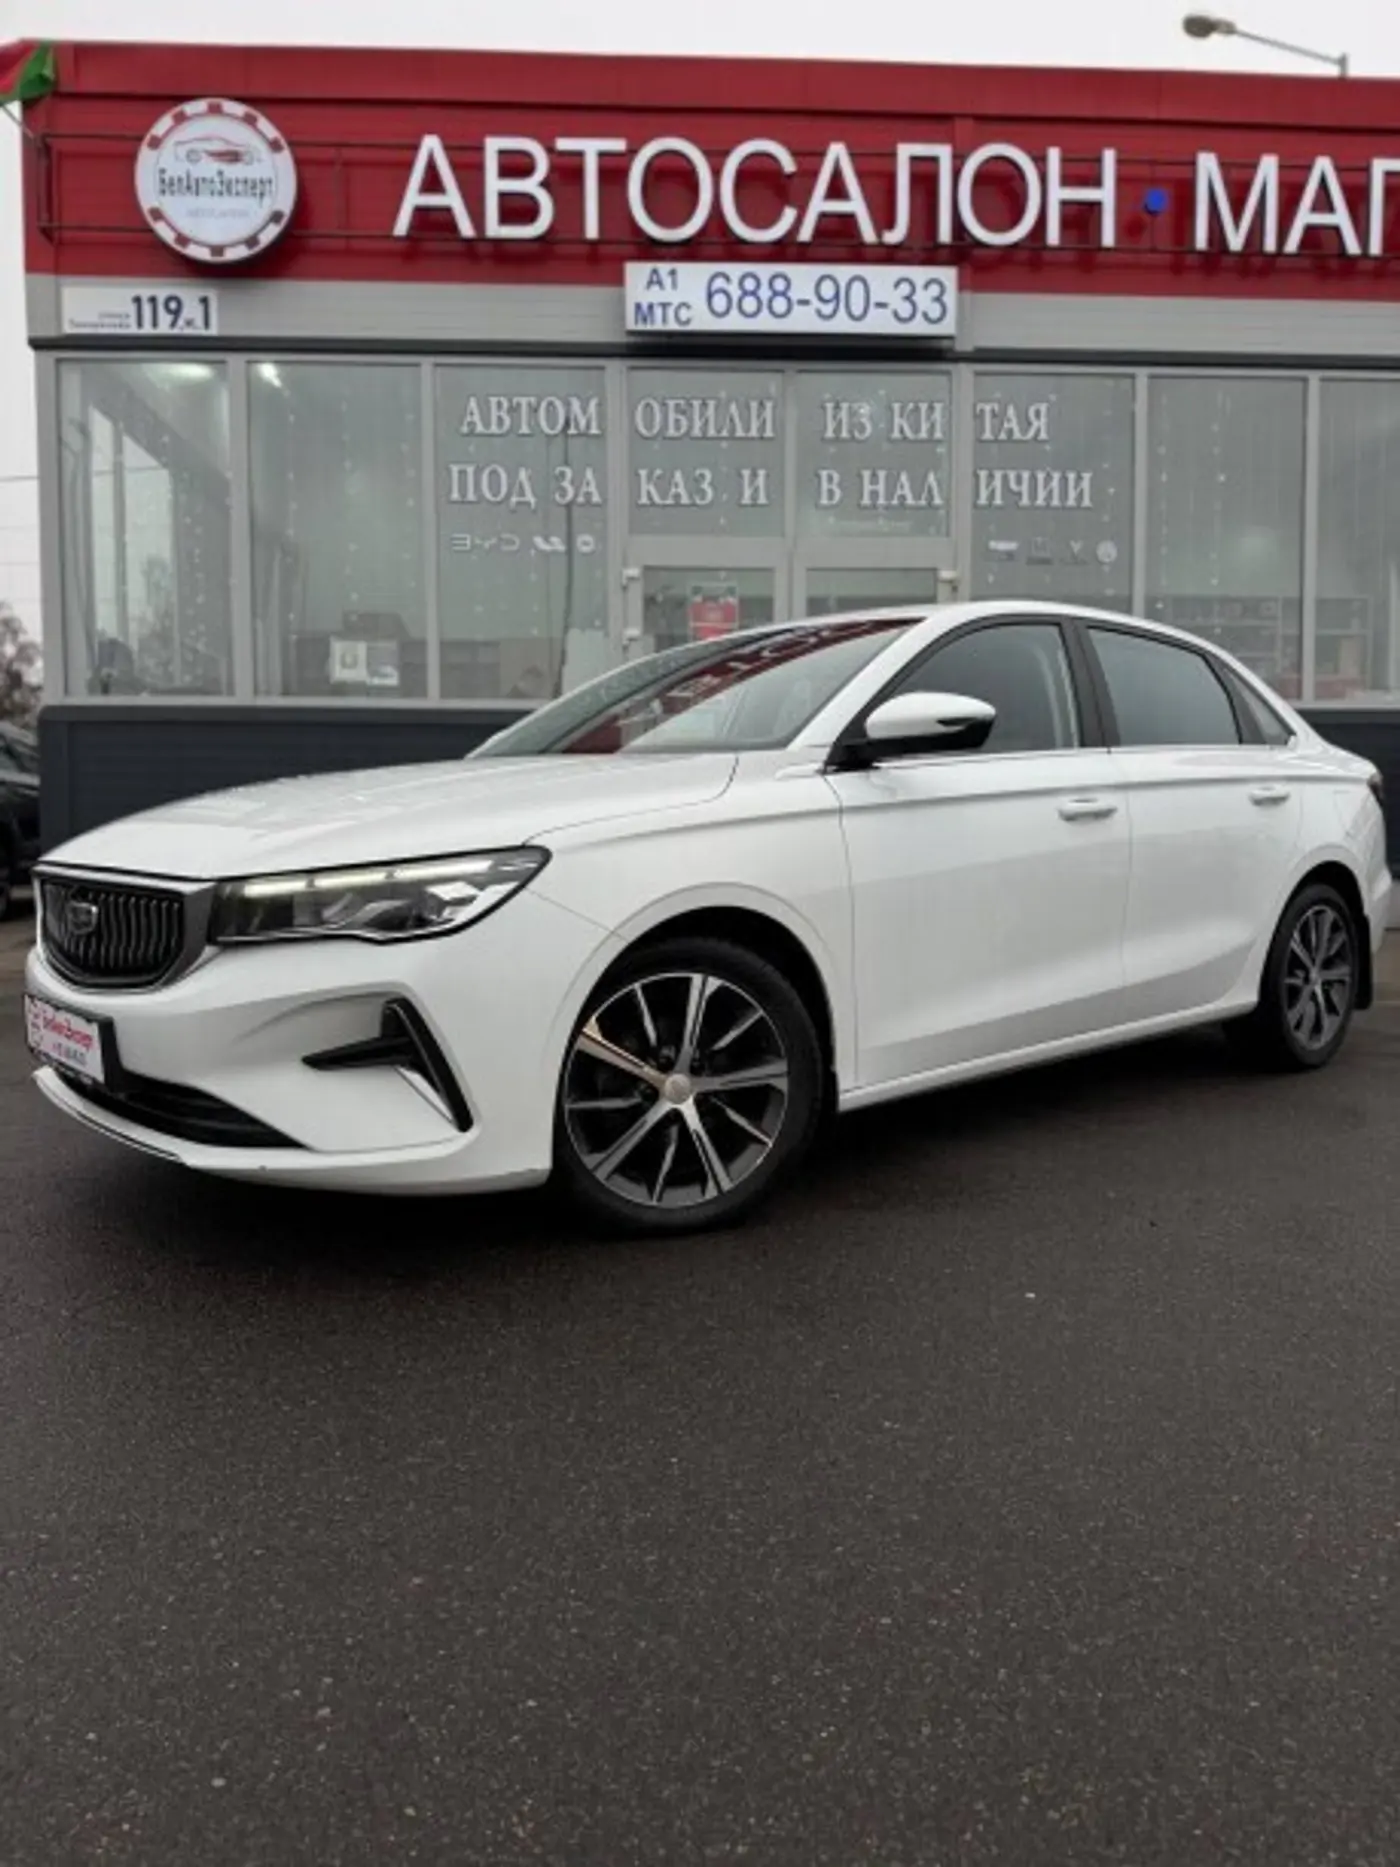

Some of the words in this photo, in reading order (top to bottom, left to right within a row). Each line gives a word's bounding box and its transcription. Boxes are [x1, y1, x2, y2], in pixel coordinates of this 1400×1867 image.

[392, 133, 1118, 248] АВТОСАЛОН
[633, 302, 692, 327] МТС
[706, 271, 947, 325] 688-90-33
[822, 401, 873, 440] ИЗ
[449, 464, 538, 510] ПОД
[740, 469, 769, 506] И
[817, 469, 842, 507] В
